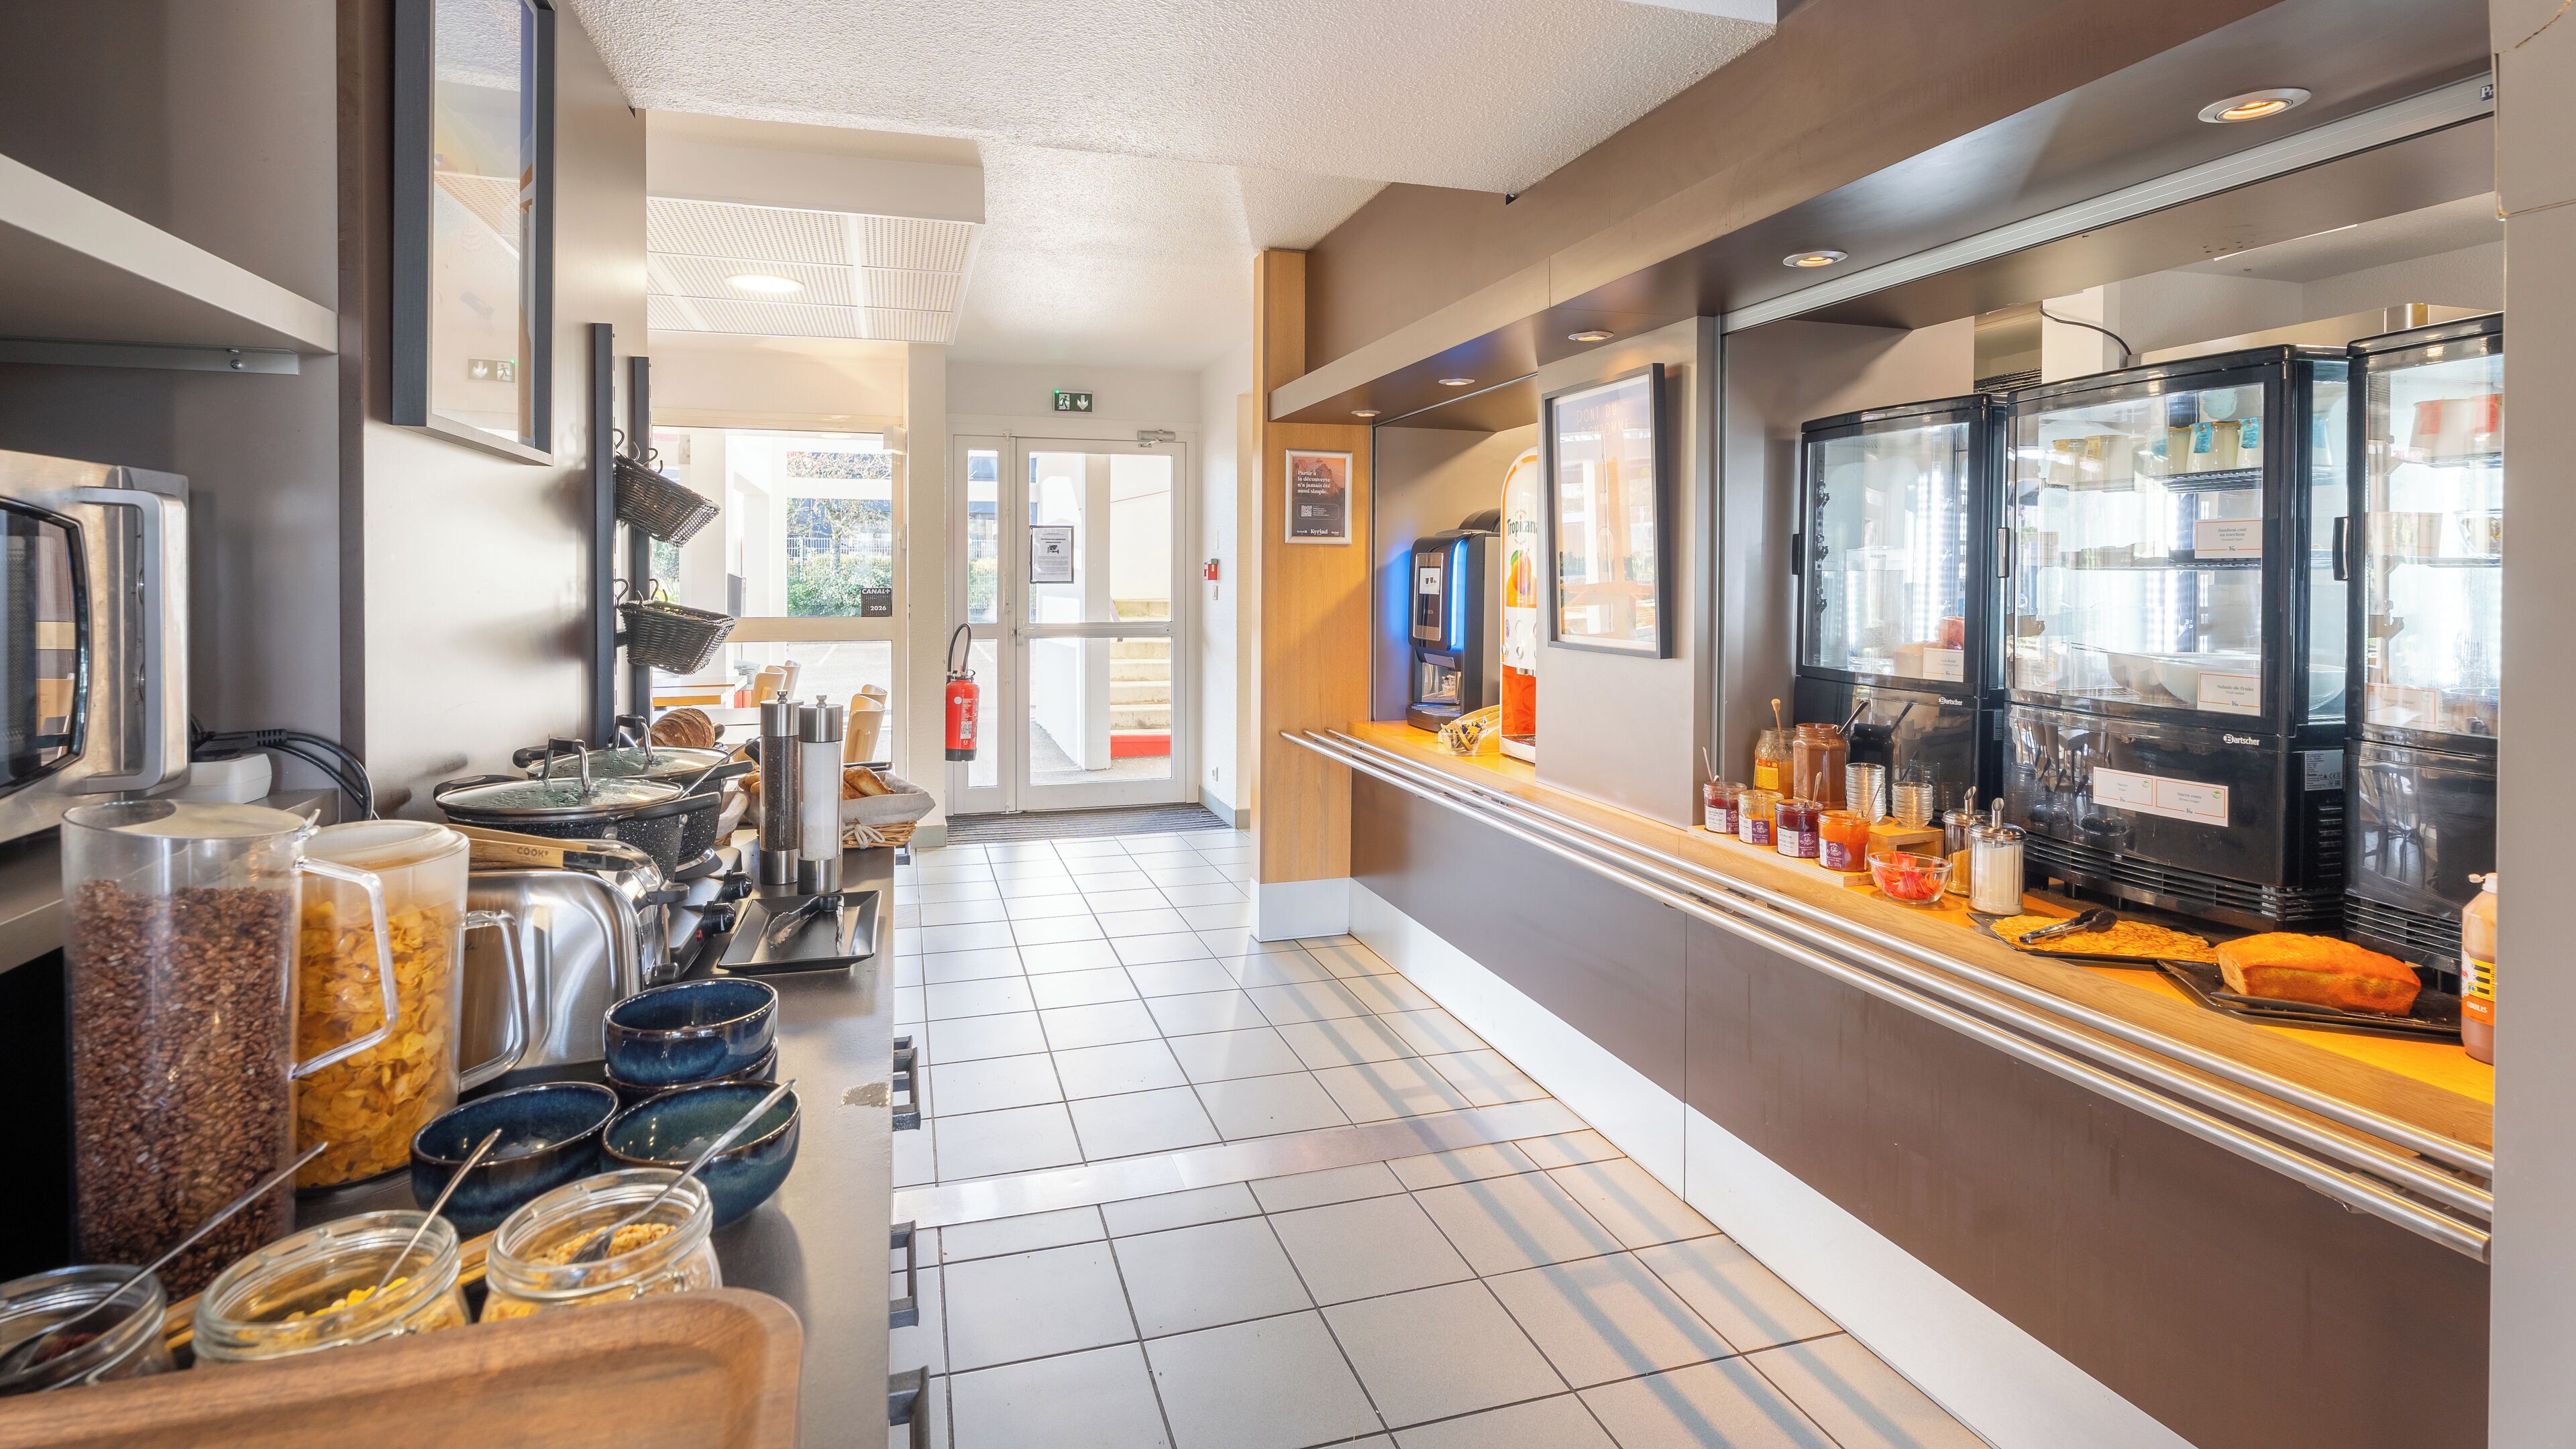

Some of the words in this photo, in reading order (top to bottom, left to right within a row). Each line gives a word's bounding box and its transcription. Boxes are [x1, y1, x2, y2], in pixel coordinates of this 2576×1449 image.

[1938, 696, 1963, 706] Bartscher
[2223, 733, 2260, 746] Bartscher
[2467, 1000, 2488, 1014] COULIS
